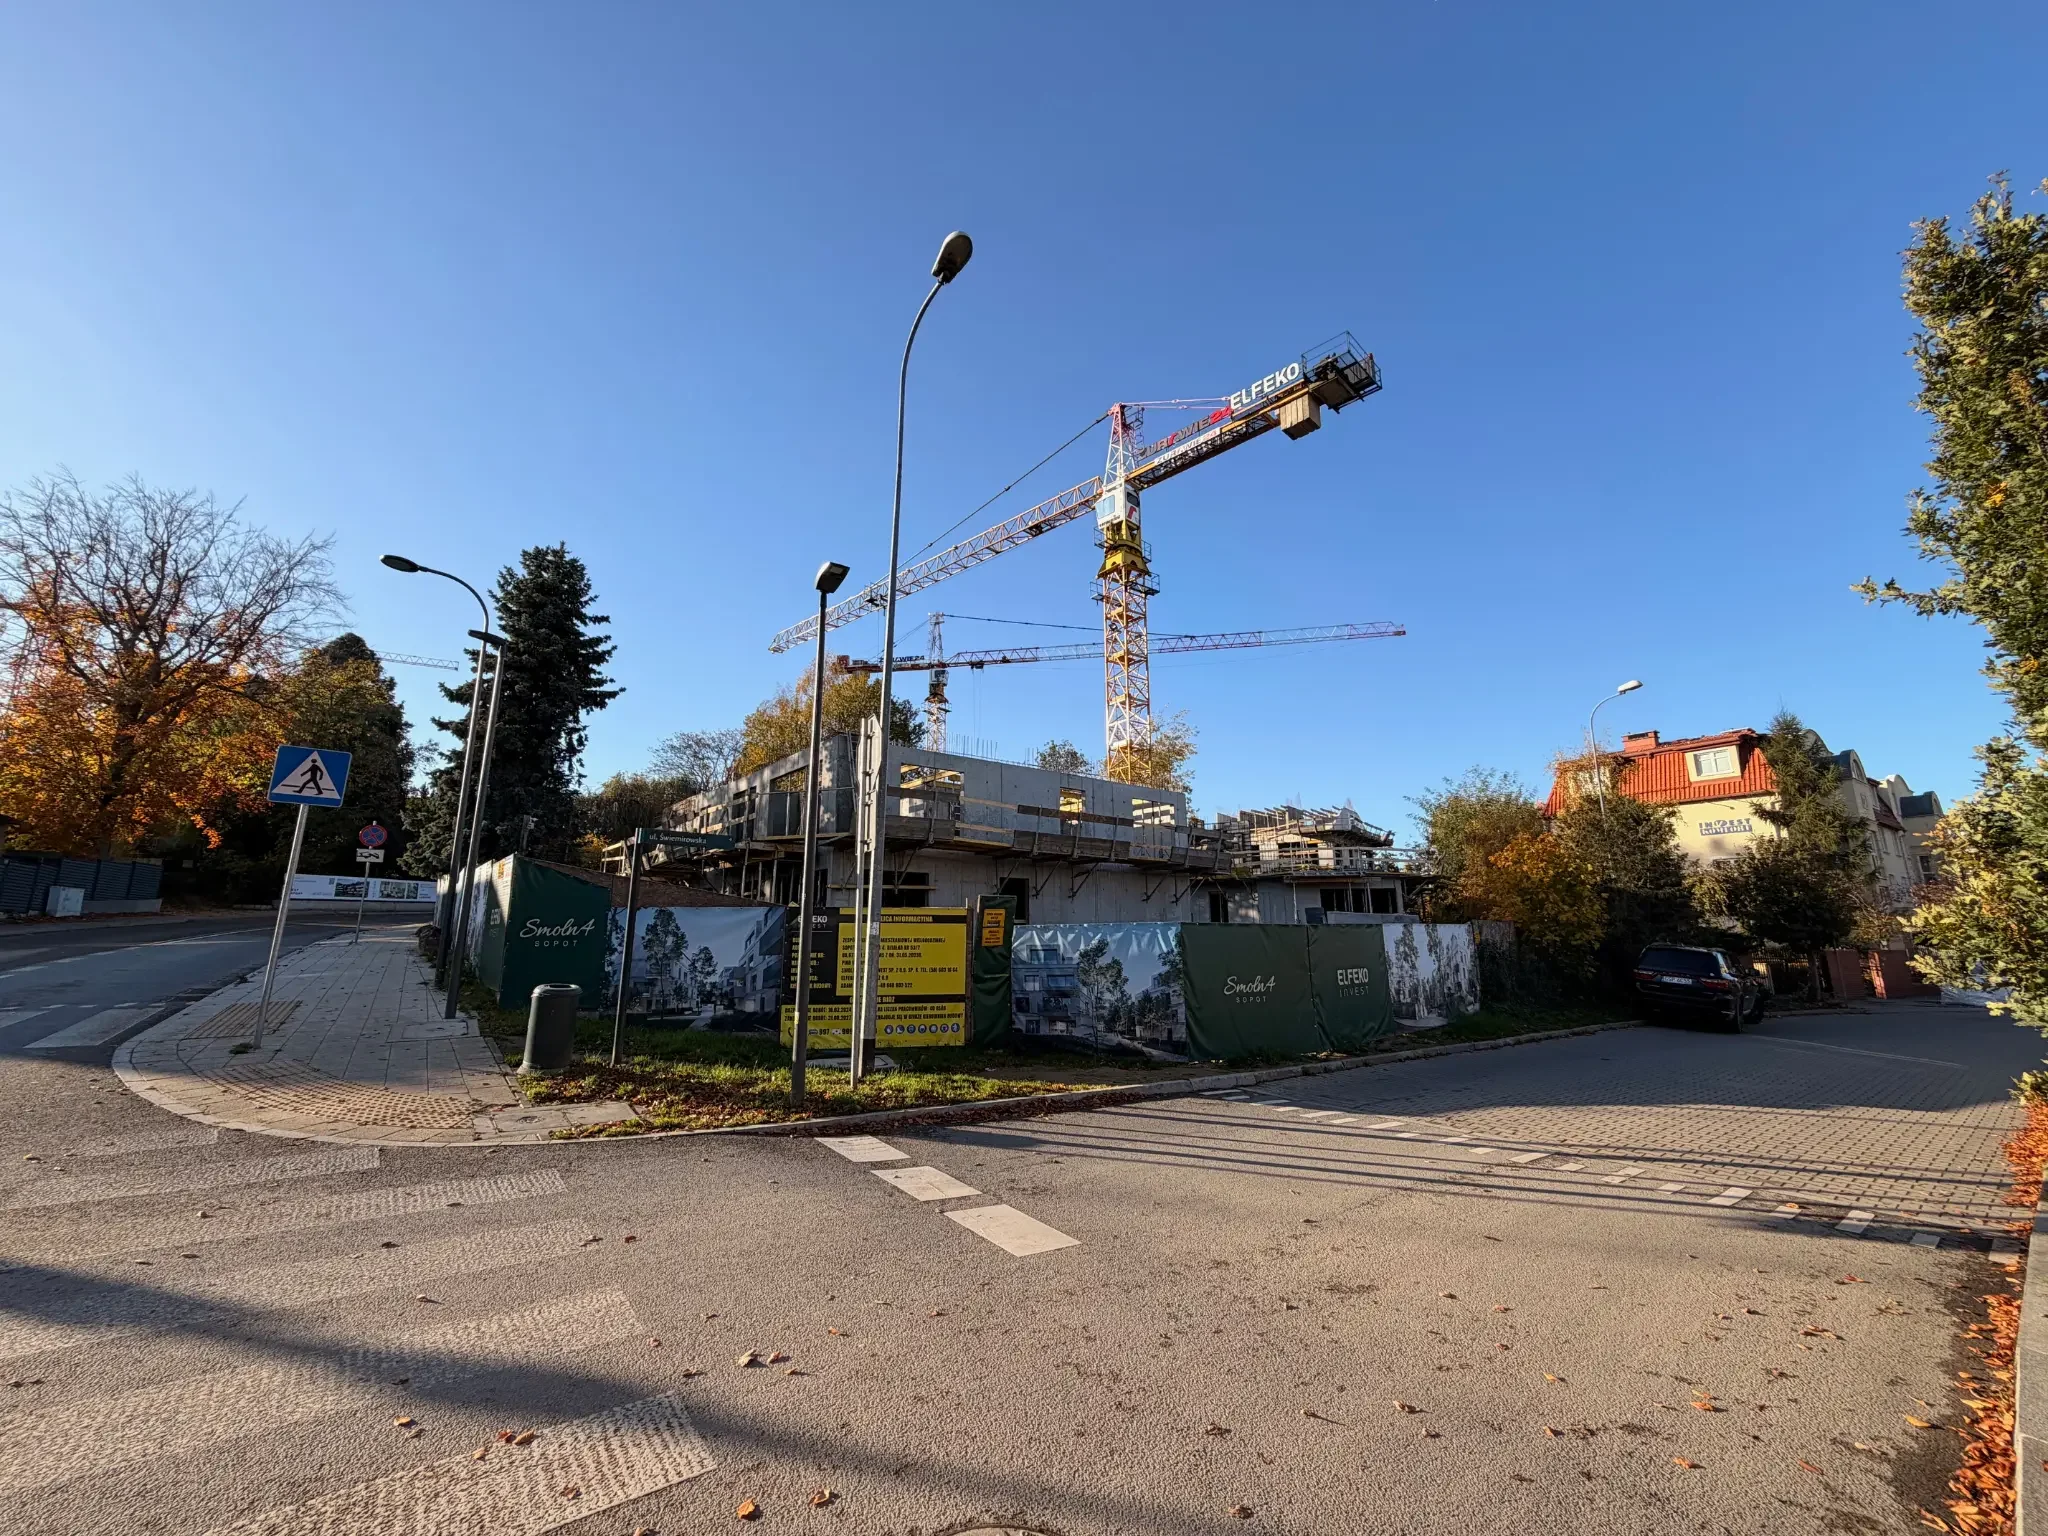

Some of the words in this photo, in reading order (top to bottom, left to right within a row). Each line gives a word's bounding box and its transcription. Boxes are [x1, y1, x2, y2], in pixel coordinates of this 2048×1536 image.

[1229, 362, 1300, 411] ELFEKO
[660, 833, 707, 844] Świemirowska
[797, 915, 828, 923] EEKO
[1337, 968, 1369, 986] ELFEKO
[1339, 986, 1369, 997] INVEST
